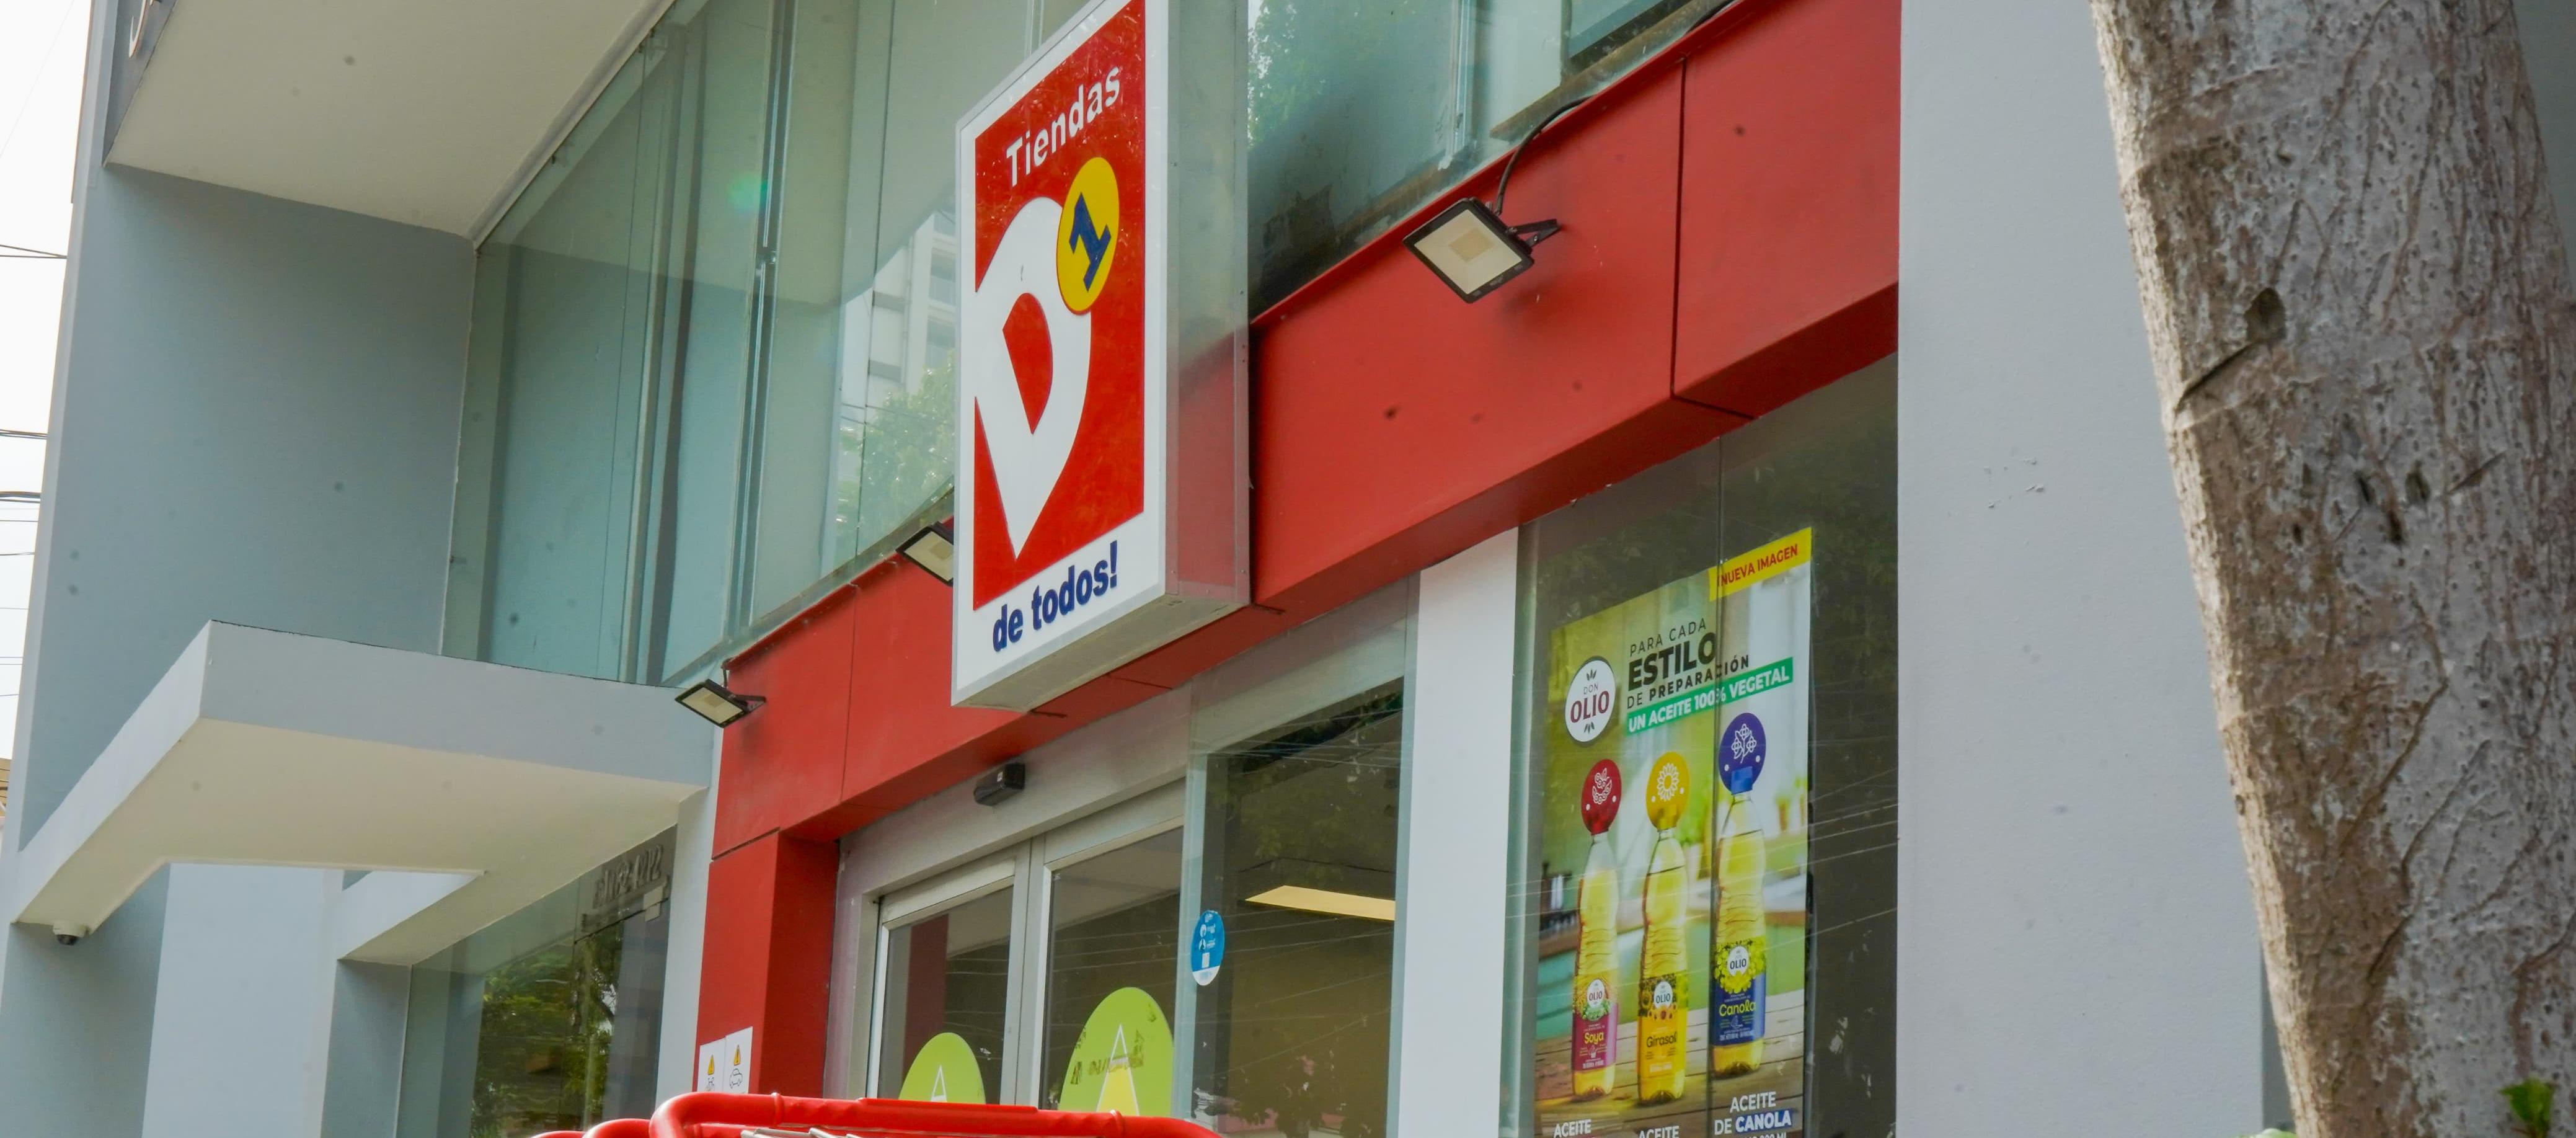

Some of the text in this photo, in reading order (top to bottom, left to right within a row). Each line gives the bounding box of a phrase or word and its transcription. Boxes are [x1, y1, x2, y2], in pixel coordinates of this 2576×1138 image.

[1006, 66, 1120, 187] Tiendas
[1757, 544, 1798, 571] IMAGEN
[993, 540, 1118, 652] de todos!
[1630, 618, 1706, 657] PARA CADA
[1628, 632, 1716, 691] ESTILO
[1583, 683, 1598, 695] DON
[1627, 654, 1749, 709] DE PREPARACIÓN
[1570, 690, 1609, 723] OLIO
[1629, 666, 1789, 732] UN ACEITE 100% VEGETAL
[1730, 958, 1746, 969] OLIO
[1656, 993, 1671, 1003] OLIO
[1719, 999, 1756, 1016] Canola
[1585, 1031, 1604, 1045] Soya
[1730, 1091, 1776, 1113] ACEITE
[1554, 1119, 1592, 1138] ACEITE
[1714, 1110, 1792, 1135] DE CANOLA
